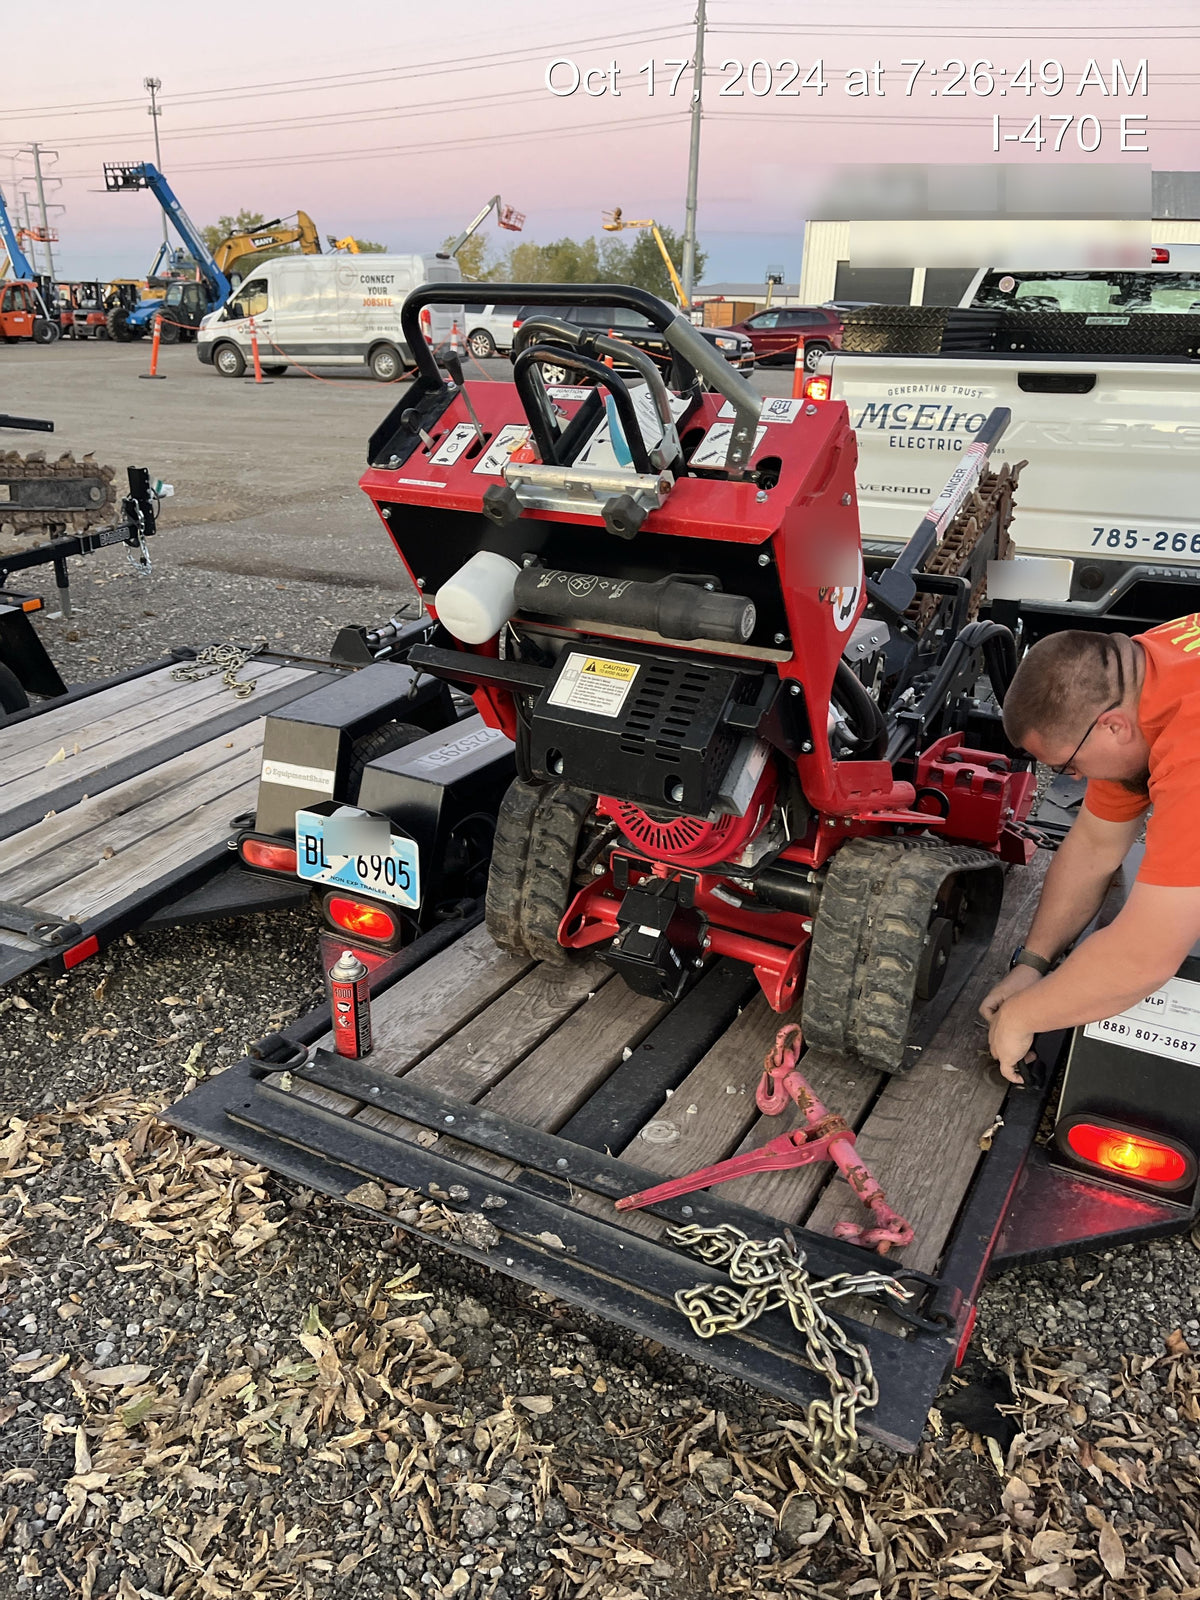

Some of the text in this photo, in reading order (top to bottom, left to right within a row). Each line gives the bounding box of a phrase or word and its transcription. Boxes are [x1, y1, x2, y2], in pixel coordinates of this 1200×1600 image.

[254, 236, 274, 247] SANY
[360, 274, 395, 284] CONNECT
[367, 286, 388, 296] YOUR
[887, 384, 983, 399] GENERATING TRUST
[772, 400, 792, 413] 811
[855, 403, 987, 433] McElro
[890, 436, 962, 451] ELECTRIC
[856, 483, 931, 495] VERADO
[940, 467, 968, 499] DANGER
[603, 663, 630, 673] CAUTION
[272, 768, 330, 785] EquipmentShare
[330, 875, 387, 896] NON EXP TRAILER
[1098, 1020, 1197, 1053] (888) 807-3687
